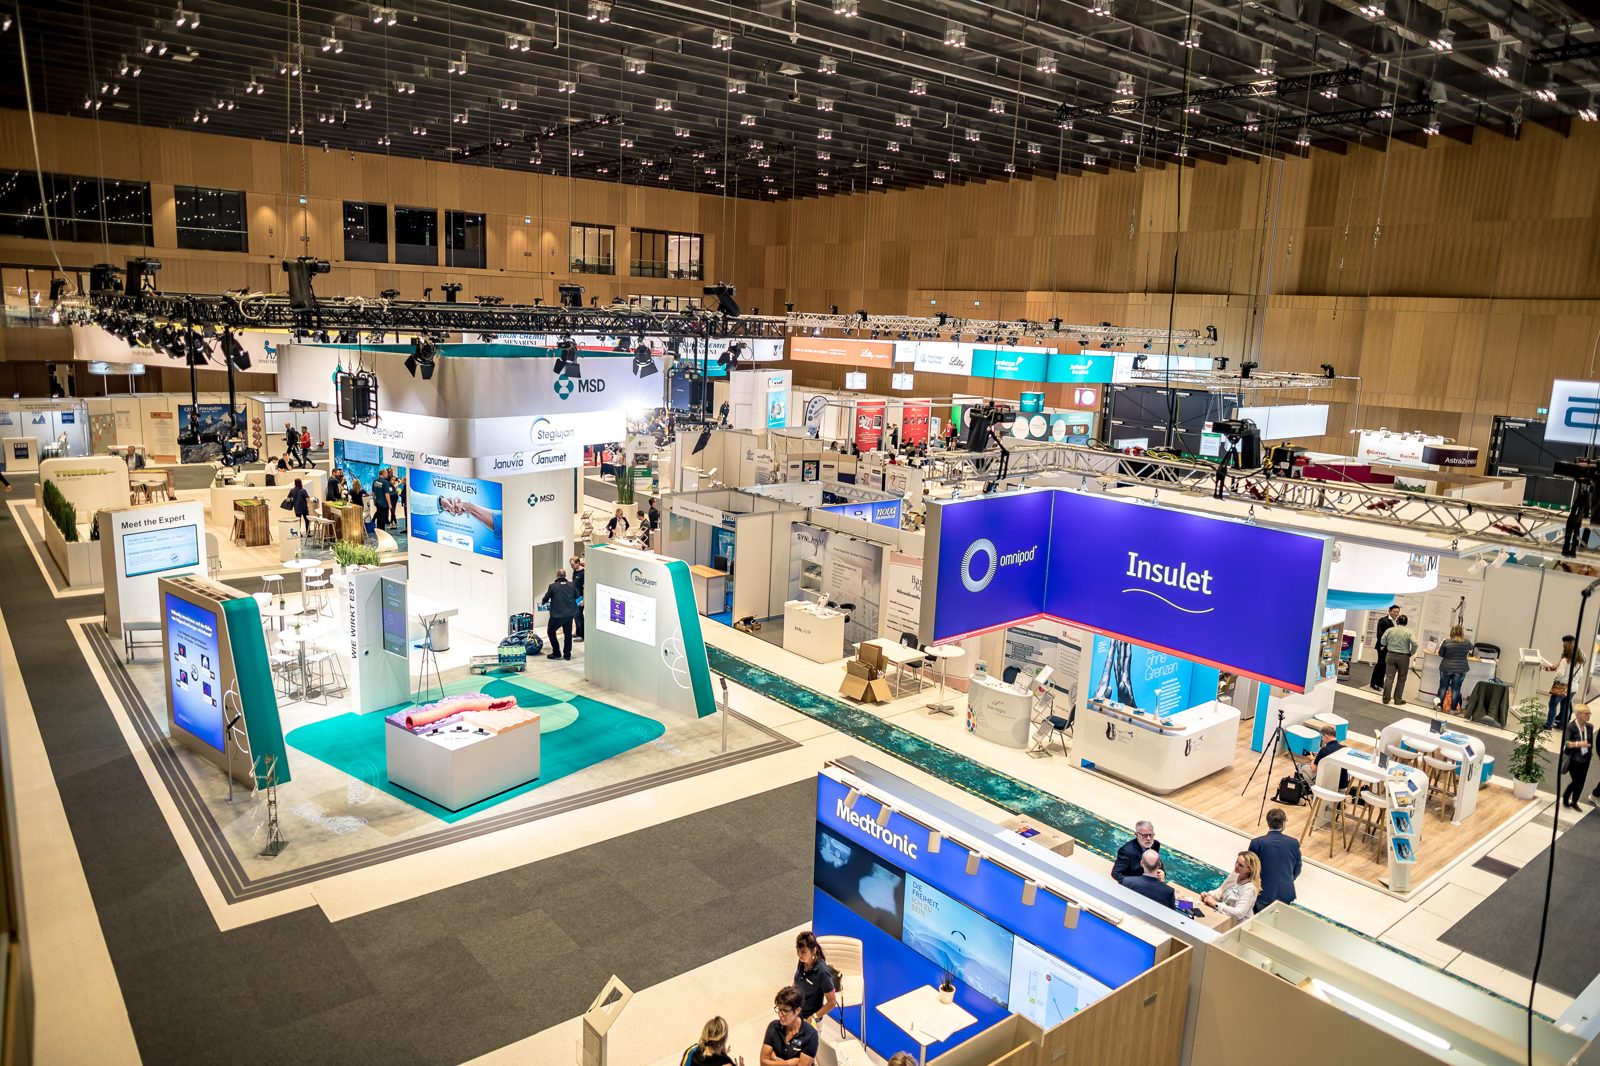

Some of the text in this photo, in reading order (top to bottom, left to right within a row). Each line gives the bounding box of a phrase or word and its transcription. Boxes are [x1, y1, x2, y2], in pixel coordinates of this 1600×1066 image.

[578, 378, 606, 393] MSD
[537, 428, 574, 441] Steglujan
[392, 448, 414, 462] Januvia
[424, 454, 450, 468] Janumet
[536, 453, 567, 464] Janumet
[493, 457, 524, 470] Januvia
[432, 479, 477, 495] VERTRAUEN
[540, 494, 554, 502] MSD
[121, 520, 142, 530] Meet
[158, 514, 186, 524] Expert
[1000, 546, 1035, 566] omnipod
[1126, 551, 1213, 595] Insulet
[1144, 662, 1178, 680] Grenzen
[836, 798, 918, 860] Medtronic
[912, 881, 922, 890] DIE
